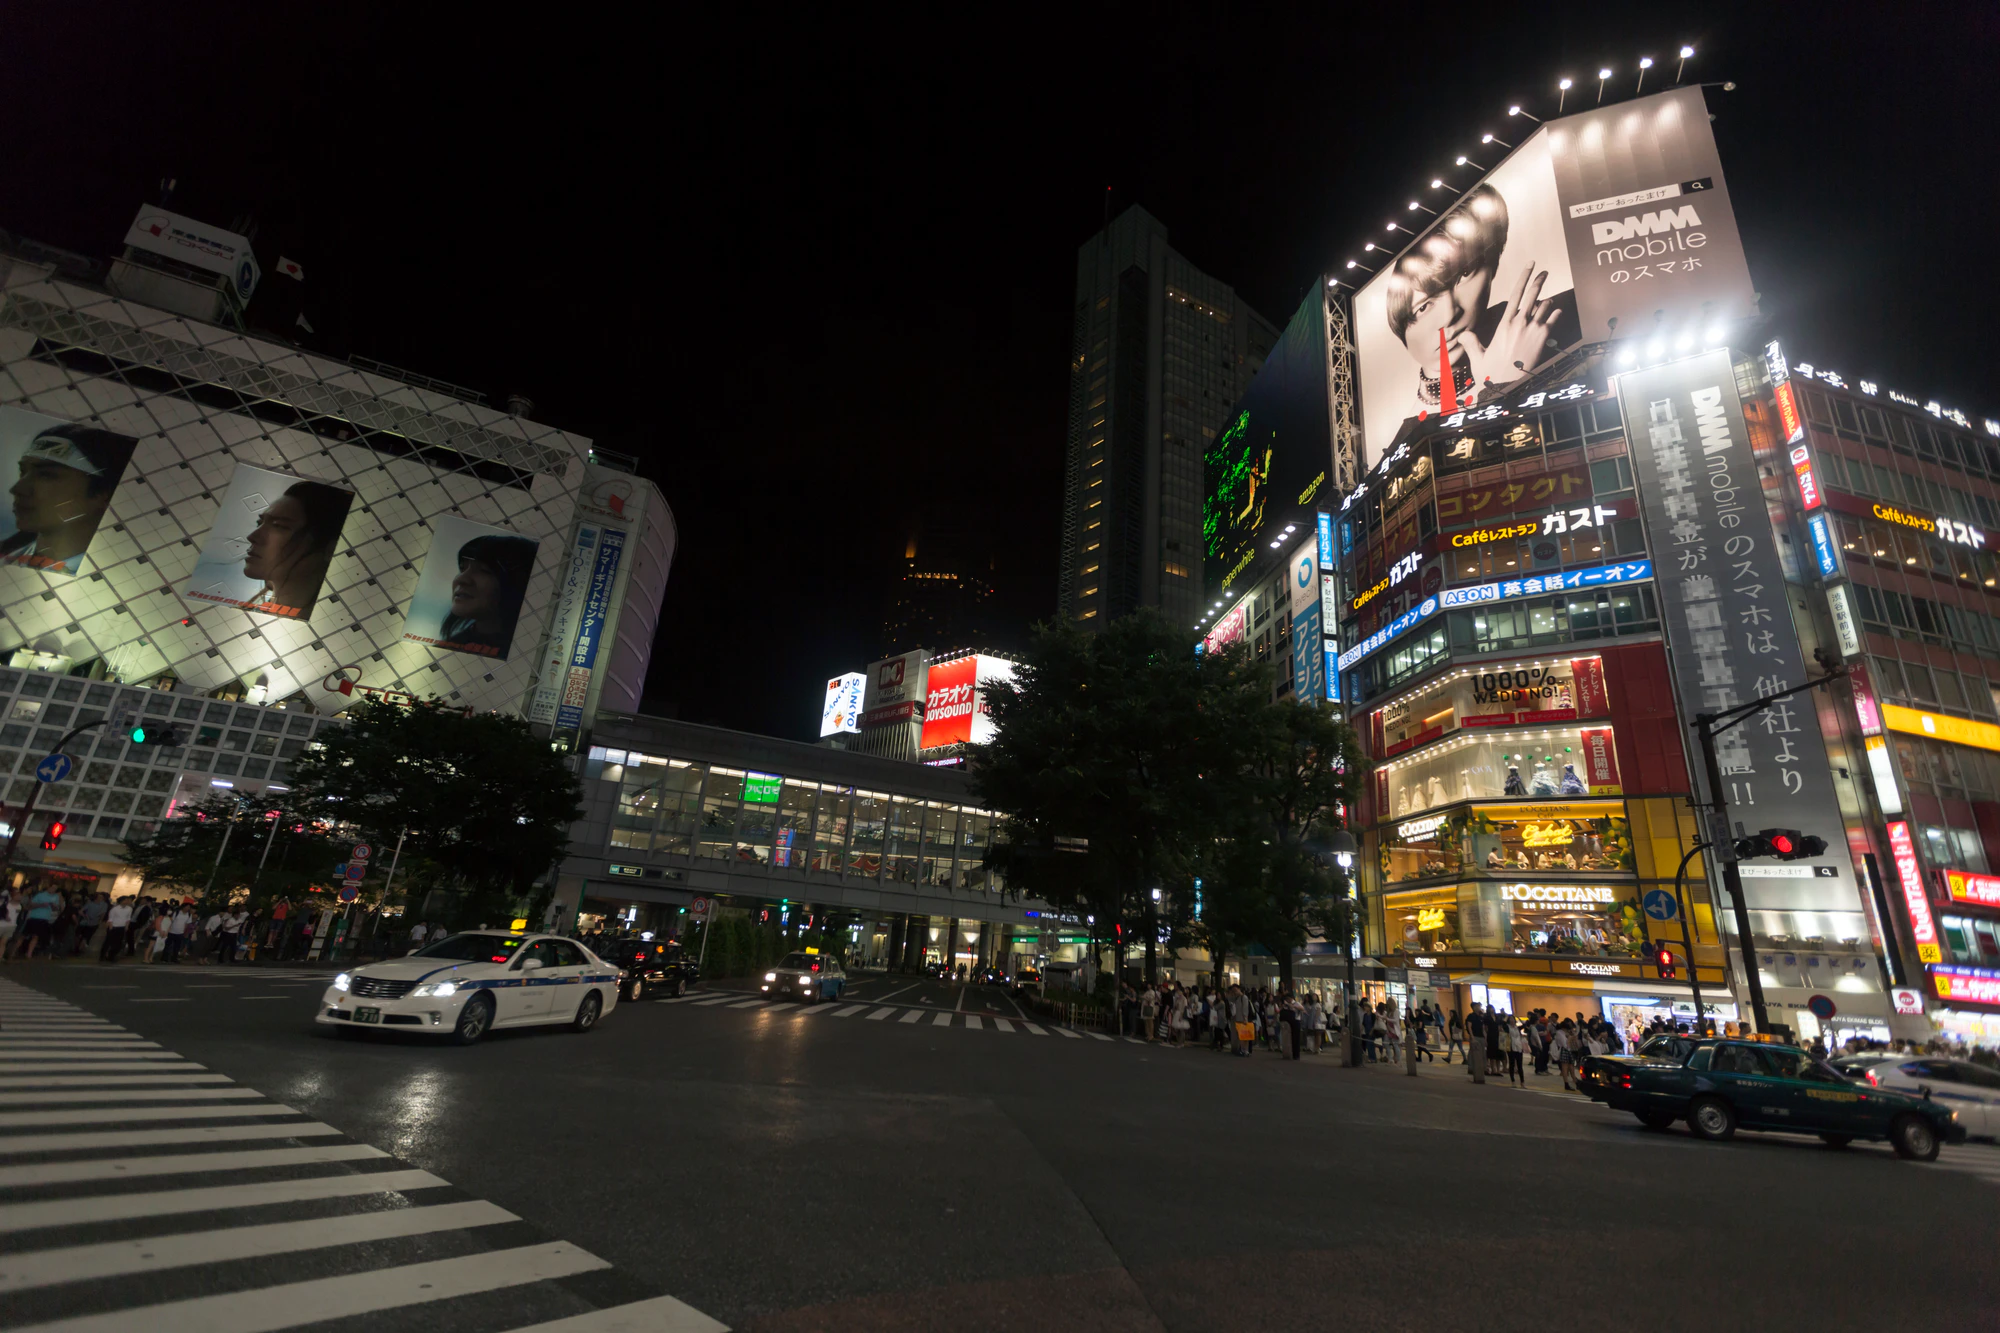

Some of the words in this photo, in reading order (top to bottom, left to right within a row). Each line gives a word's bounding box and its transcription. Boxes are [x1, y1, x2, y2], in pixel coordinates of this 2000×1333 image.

[1591, 204, 1703, 246] DMM
[1596, 230, 1707, 266] mobile
[1610, 256, 1703, 283] のスマホ
[1518, 383, 1587, 408] 月の宴
[1794, 362, 1843, 387] 月の宴
[1859, 379, 1878, 396] 9F
[1440, 404, 1503, 427] 月の宴
[1690, 385, 1733, 455] DMM
[1446, 423, 1534, 459] 月の宴
[1298, 471, 1325, 506] amazon
[1440, 471, 1584, 518] コンタクト
[1706, 455, 1741, 529] mobile
[1800, 472, 1816, 505] ガスト
[1542, 504, 1617, 536] ガスト
[1935, 516, 1985, 550] ガスト
[1220, 546, 1255, 593] paperwhite
[1389, 550, 1423, 587] ガスト
[1444, 586, 1494, 606] AEON
[1503, 563, 1647, 598] 英会話イーオン
[1295, 583, 1318, 608] eyecity
[1361, 611, 1419, 655] 英会話イーオン
[1831, 591, 1855, 650] 渋谷駅前ビル
[928, 682, 973, 709] カラオケ
[1470, 666, 1557, 694] 1000%
[1472, 682, 1558, 705] WEDDNG!
[1580, 676, 1592, 715] ドレスセール
[847, 678, 862, 727] SANKYO
[925, 701, 972, 722] JOYSOUND
[1590, 735, 1610, 781] 毎日開催
[1501, 883, 1614, 903] L'OCCITANE
[1522, 902, 1536, 910] EN
[1540, 902, 1595, 911] PROVENCE
[1570, 962, 1621, 973] L'OCCITANE
